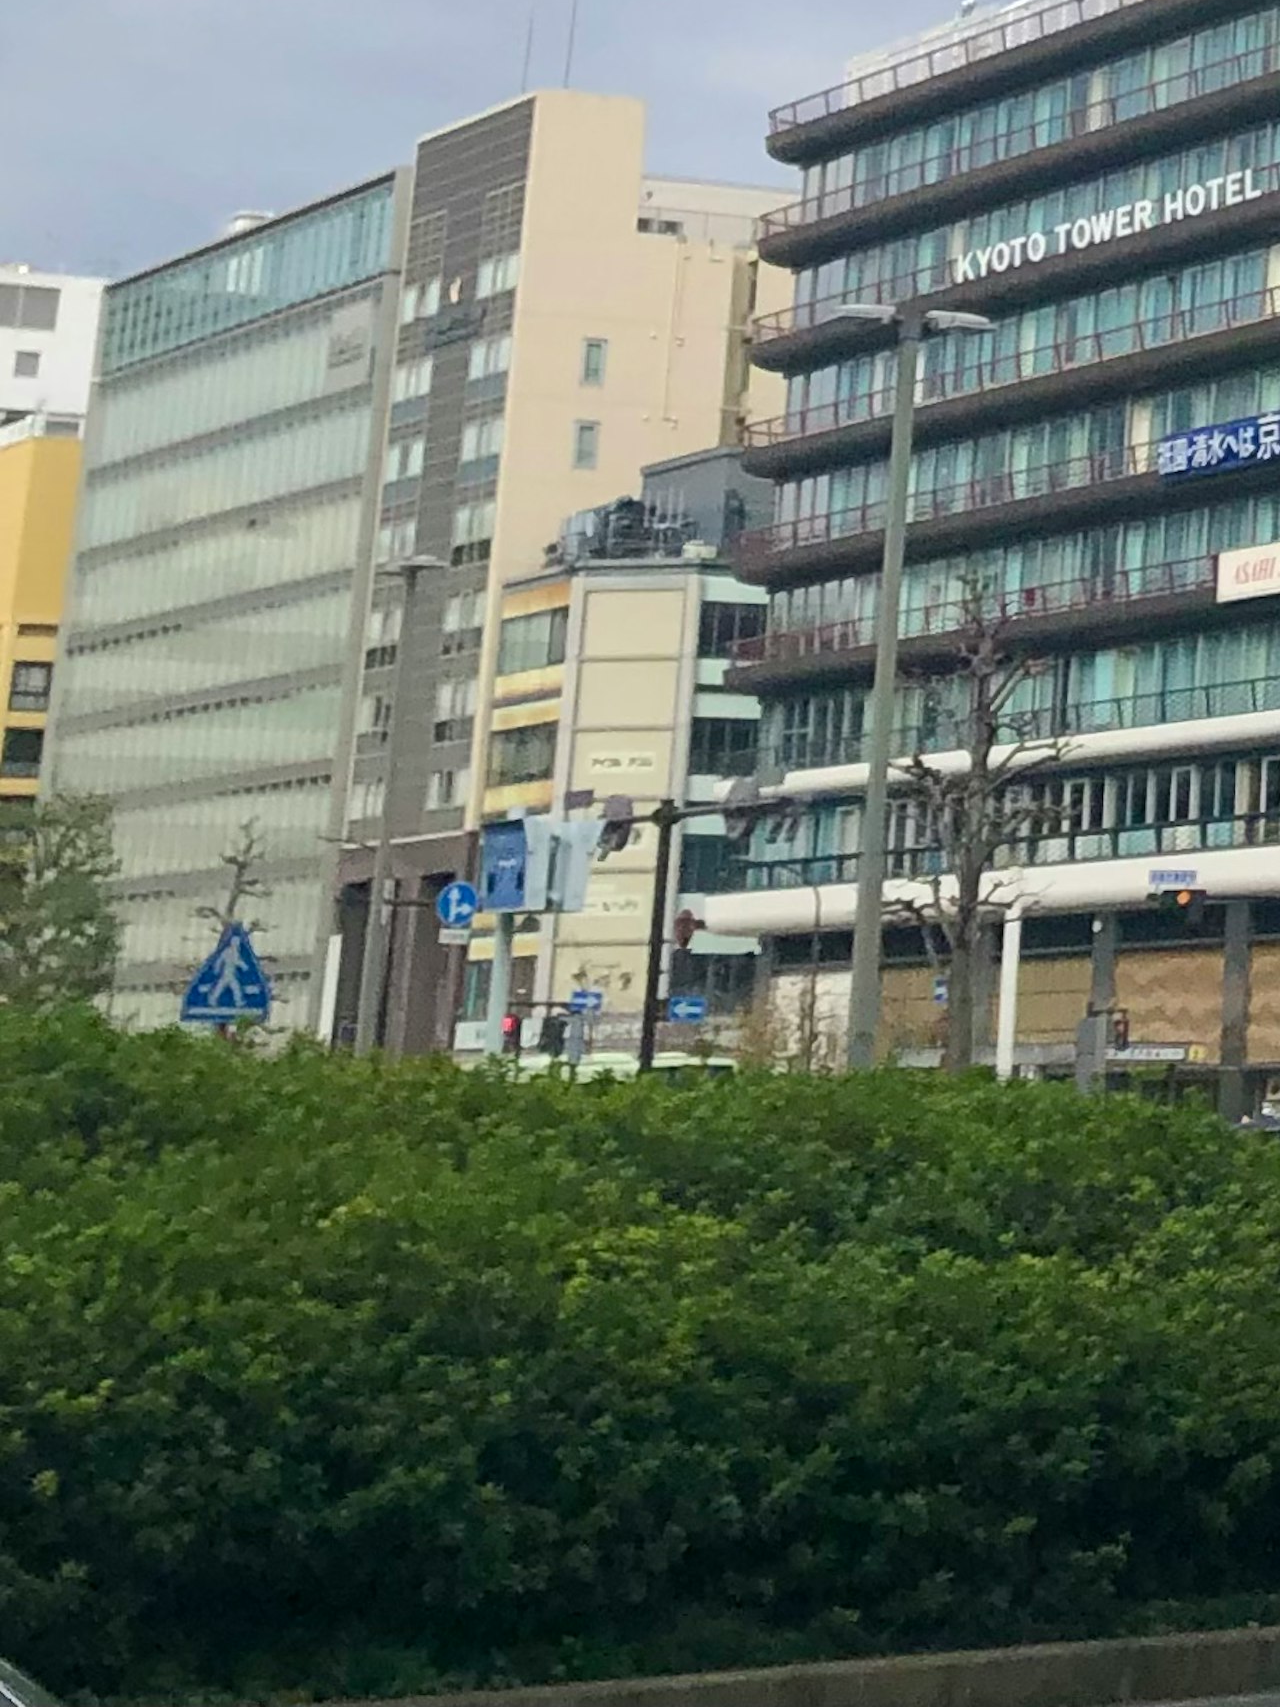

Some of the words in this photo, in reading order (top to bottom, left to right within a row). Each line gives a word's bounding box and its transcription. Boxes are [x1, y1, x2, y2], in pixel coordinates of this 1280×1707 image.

[953, 232, 1047, 285] KYOTO
[1054, 199, 1153, 254] TOWER
[1163, 169, 1263, 225] HOTEL
[1234, 554, 1276, 585] ASAHI
